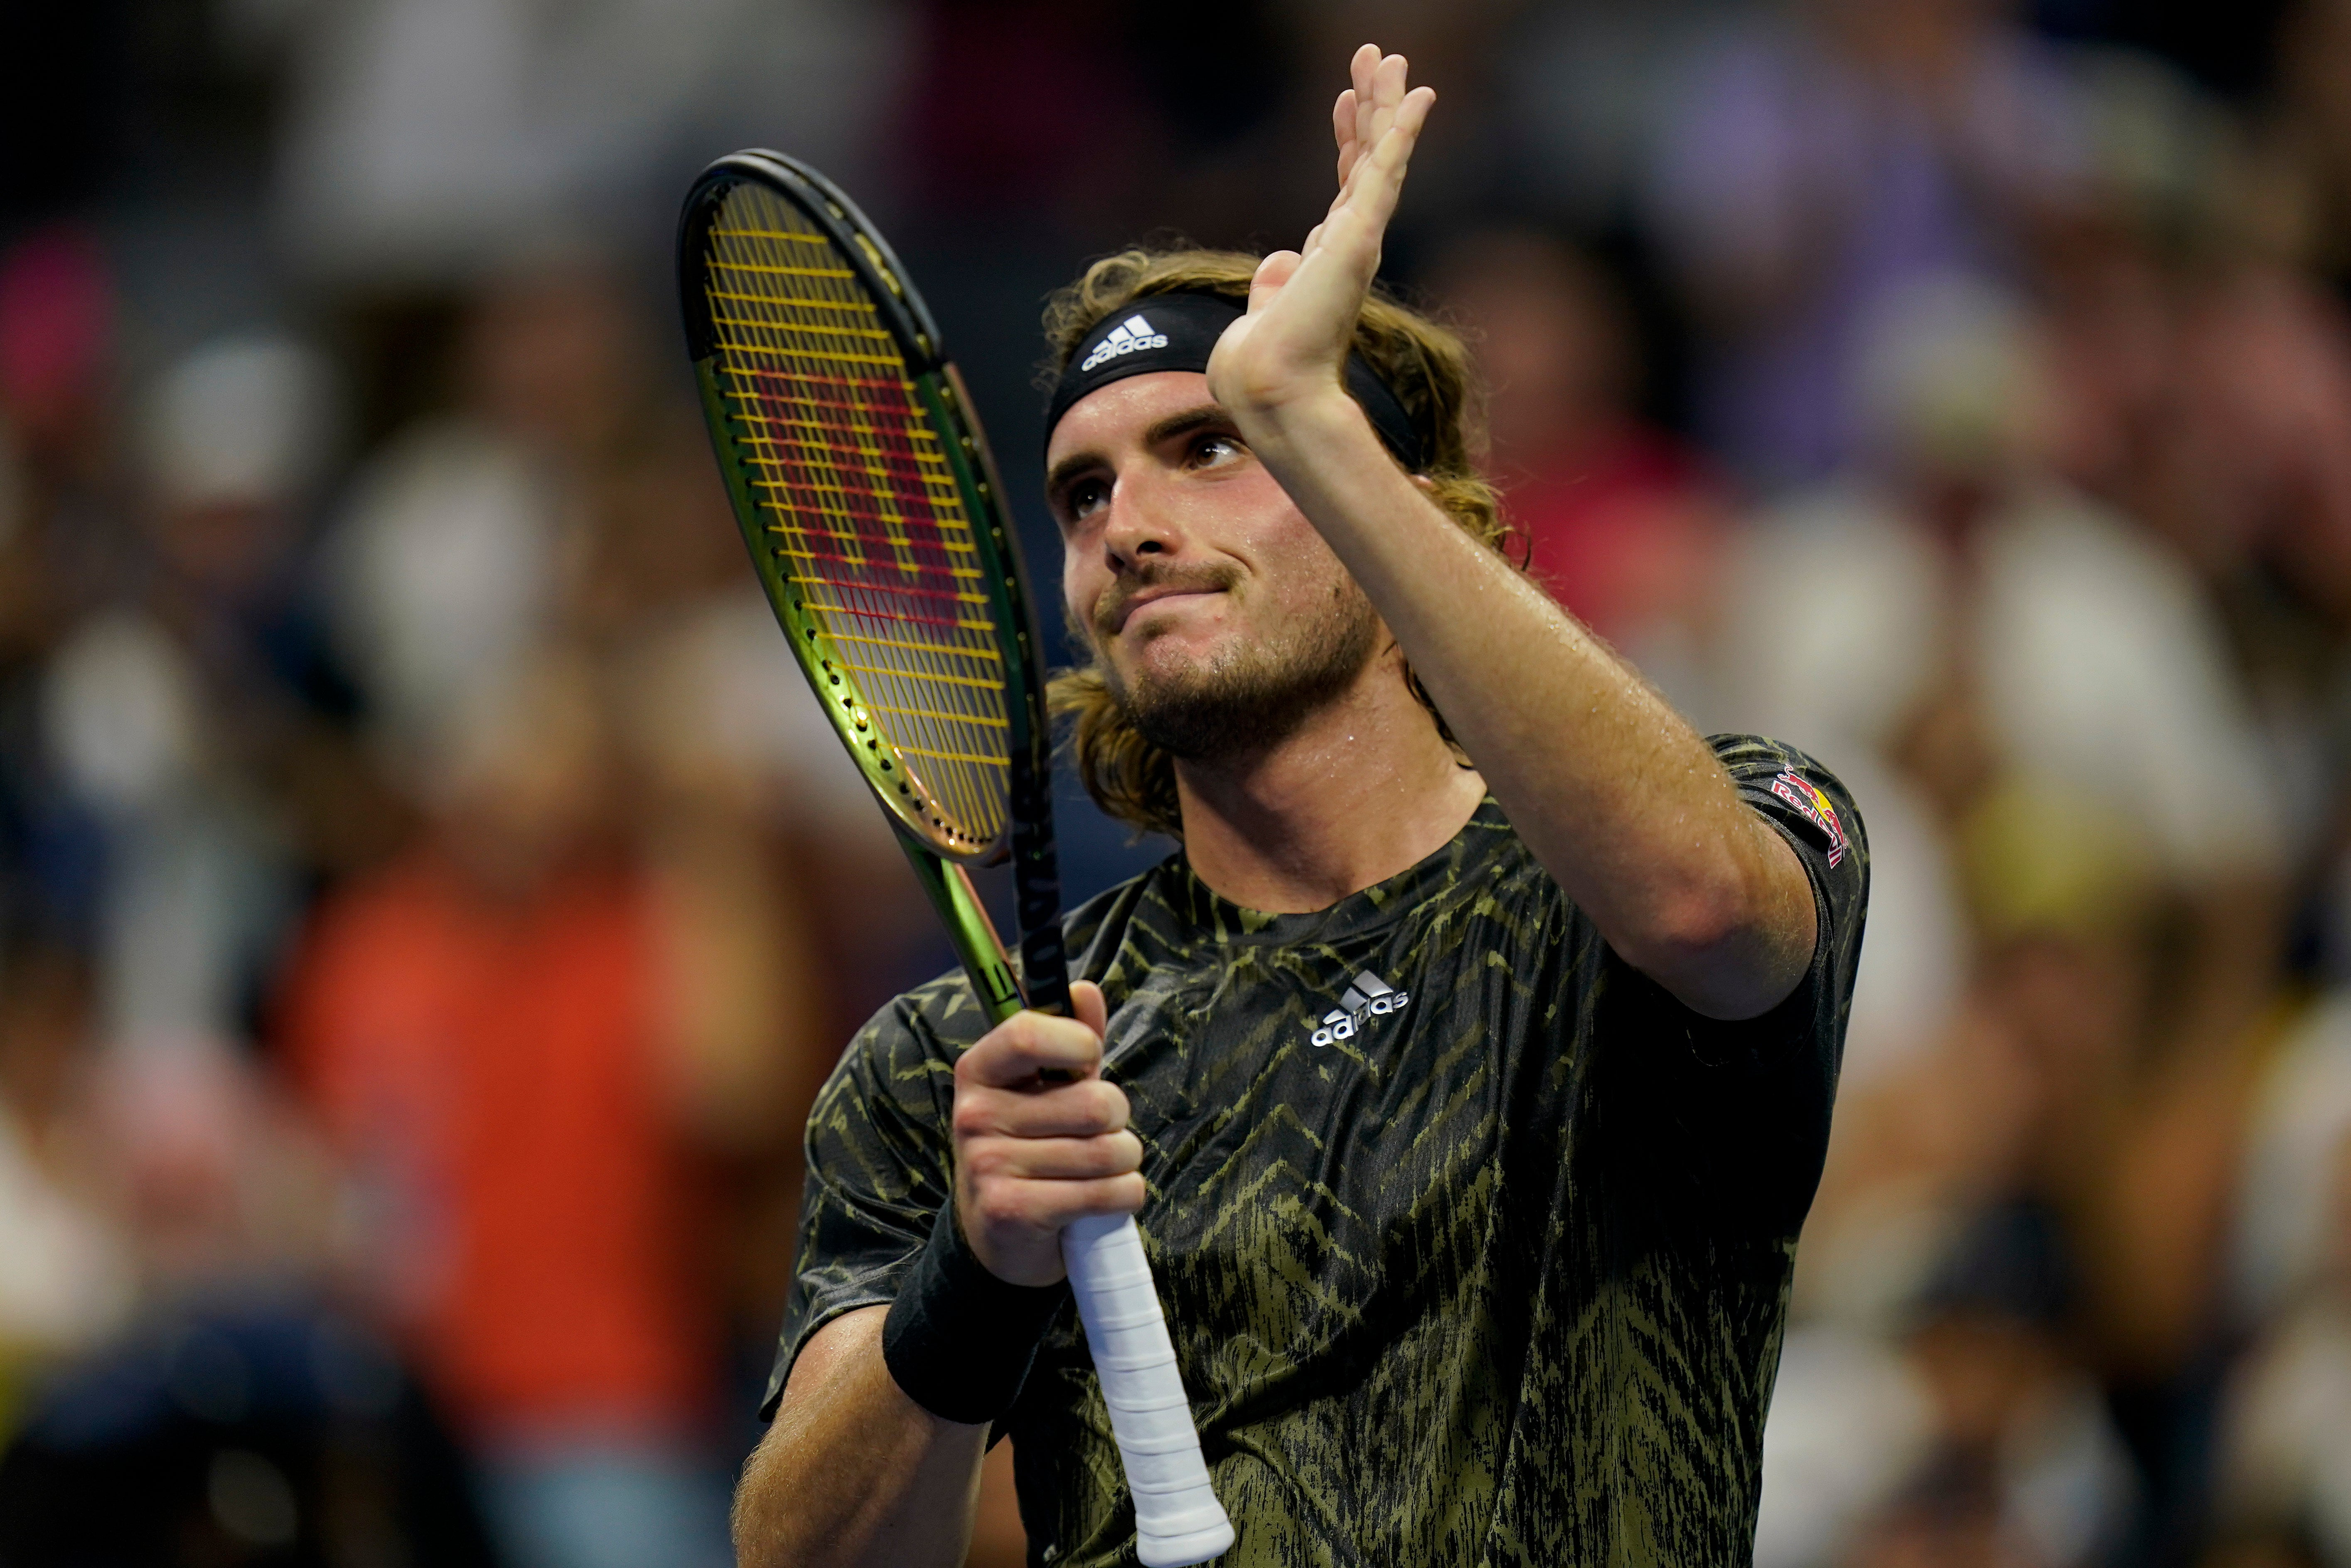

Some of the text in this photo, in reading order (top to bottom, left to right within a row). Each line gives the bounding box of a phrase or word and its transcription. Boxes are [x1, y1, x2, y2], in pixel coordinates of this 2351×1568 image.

[1081, 334, 1168, 371] adidas
[1771, 779, 1819, 823] Red
[1311, 992, 1409, 1047] adidas
